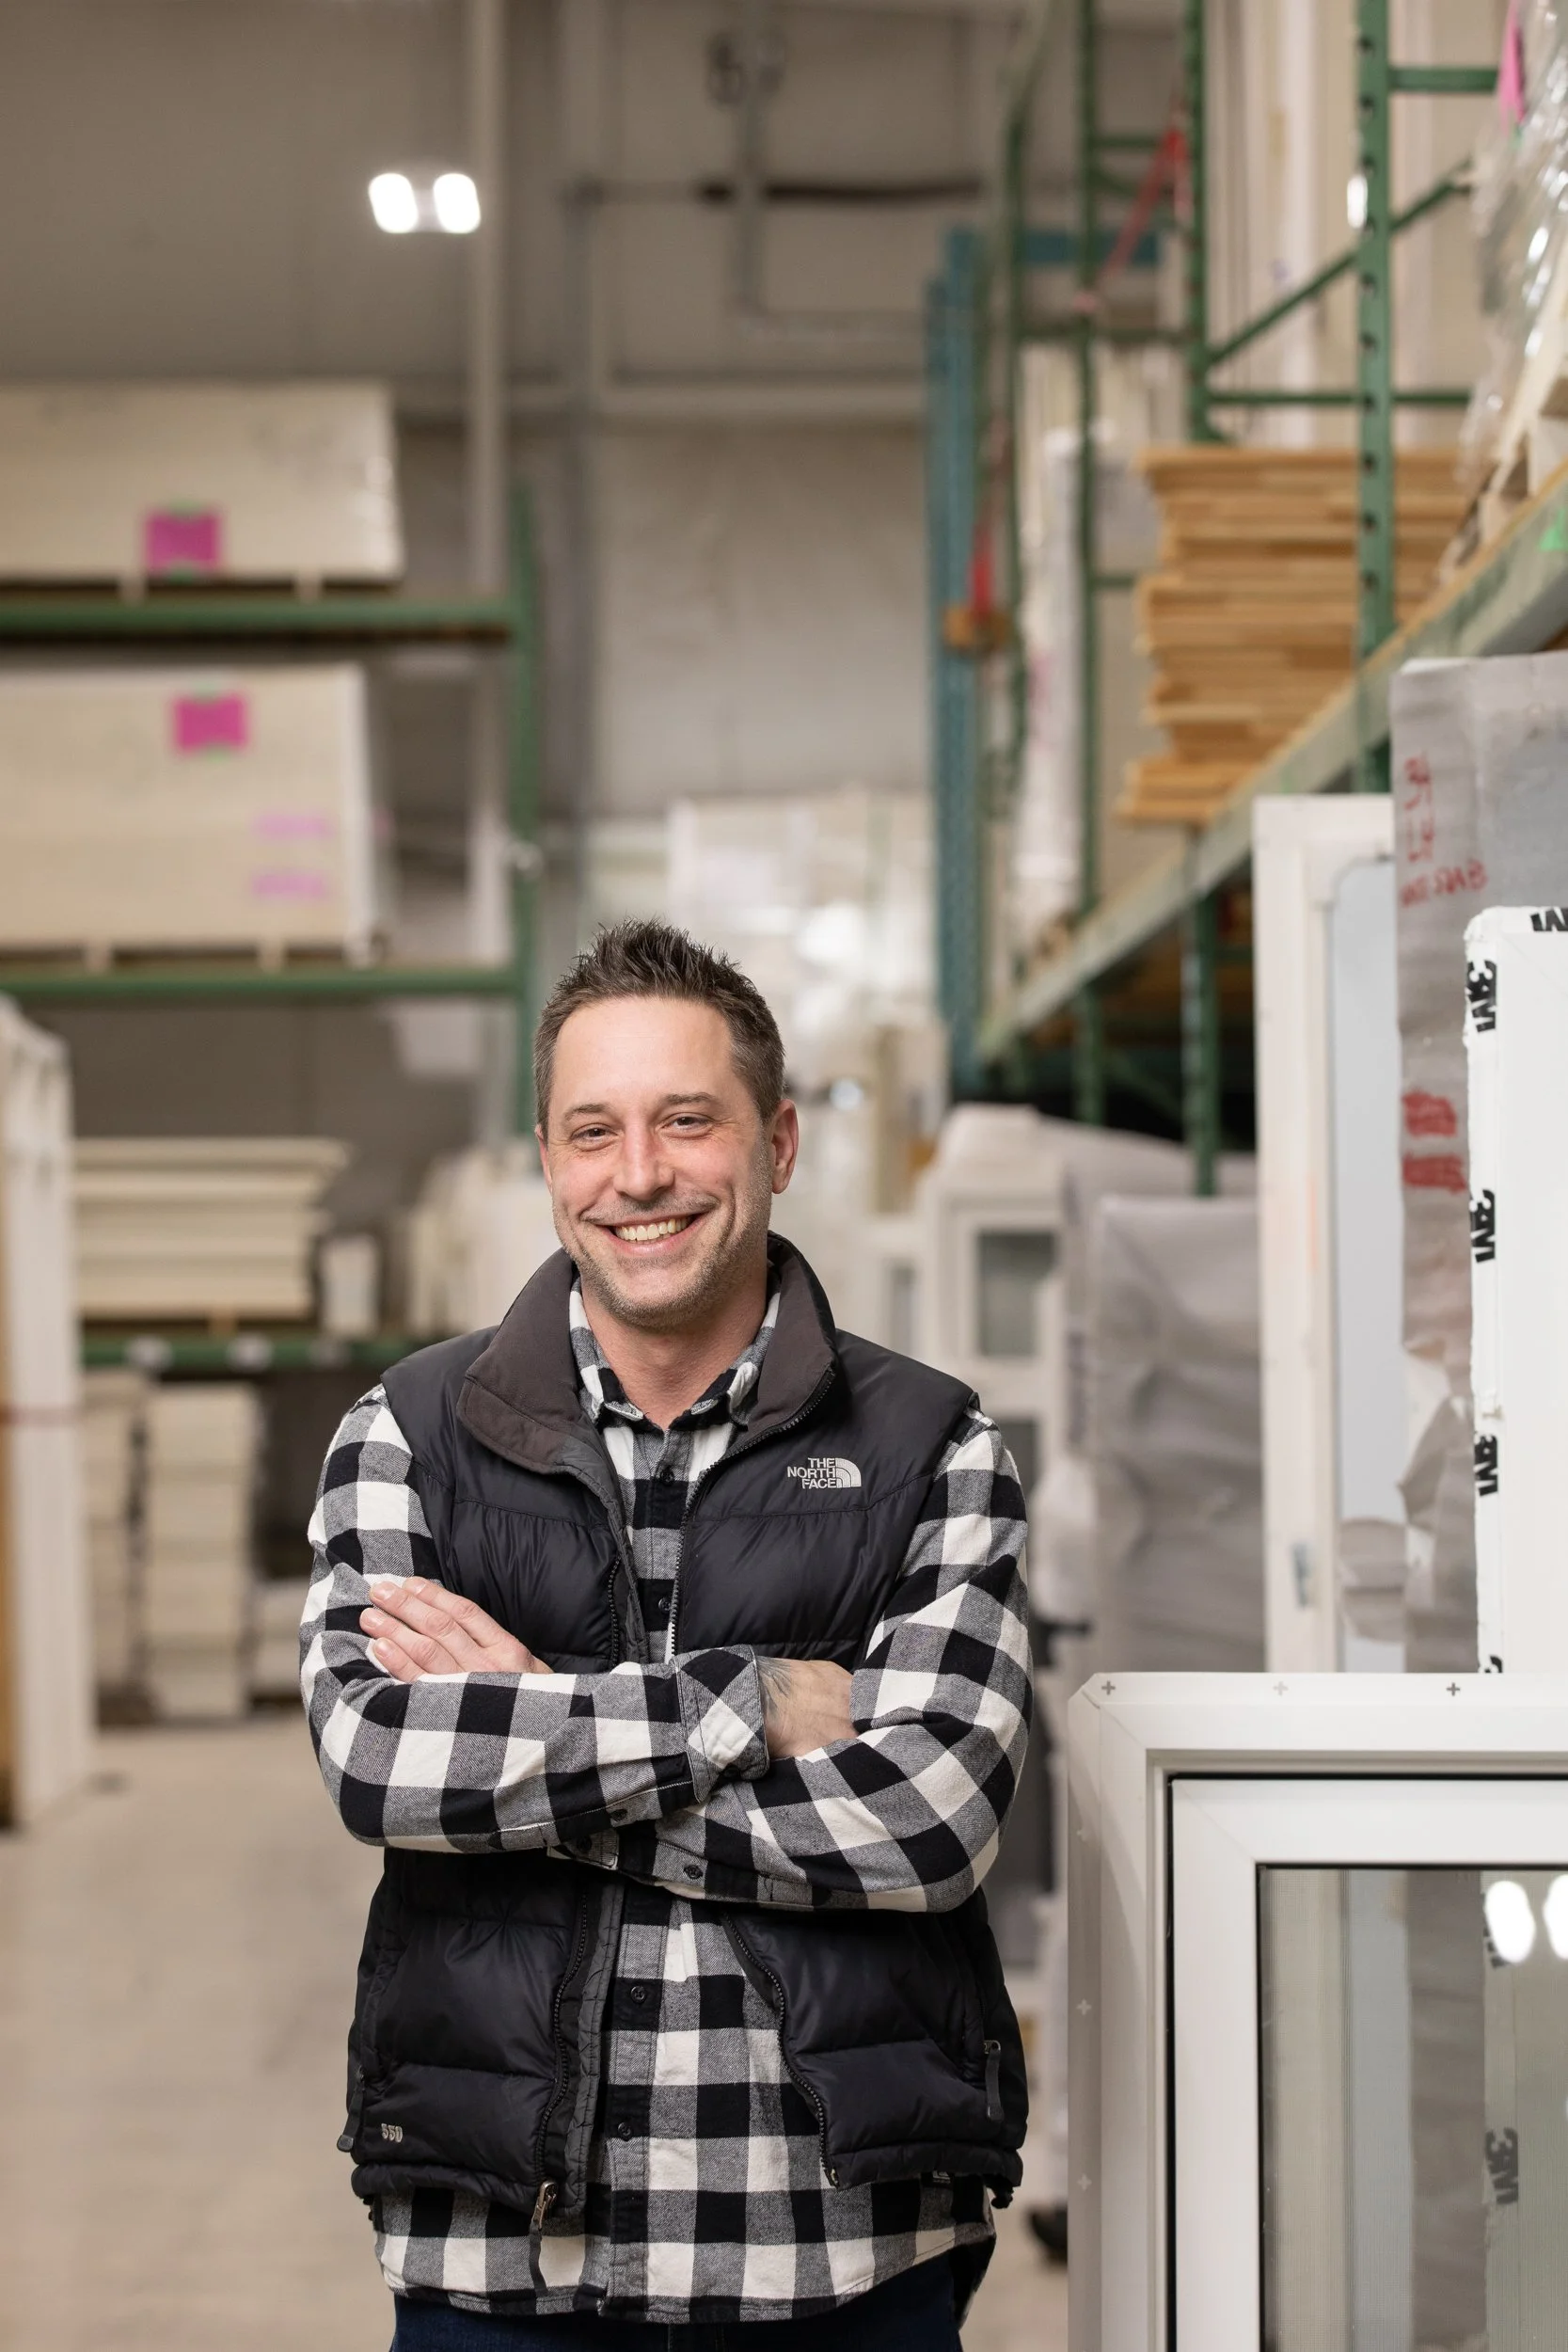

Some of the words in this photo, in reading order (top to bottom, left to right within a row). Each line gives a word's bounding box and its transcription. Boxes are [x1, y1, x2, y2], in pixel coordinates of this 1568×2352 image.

[1467, 960, 1497, 1032] 3M
[1470, 1189, 1496, 1263] 3M
[786, 1466, 836, 1479] NORTH
[801, 1477, 836, 1489] FACE
[807, 1457, 835, 1469] THE
[1485, 2127, 1519, 2204] 3M
